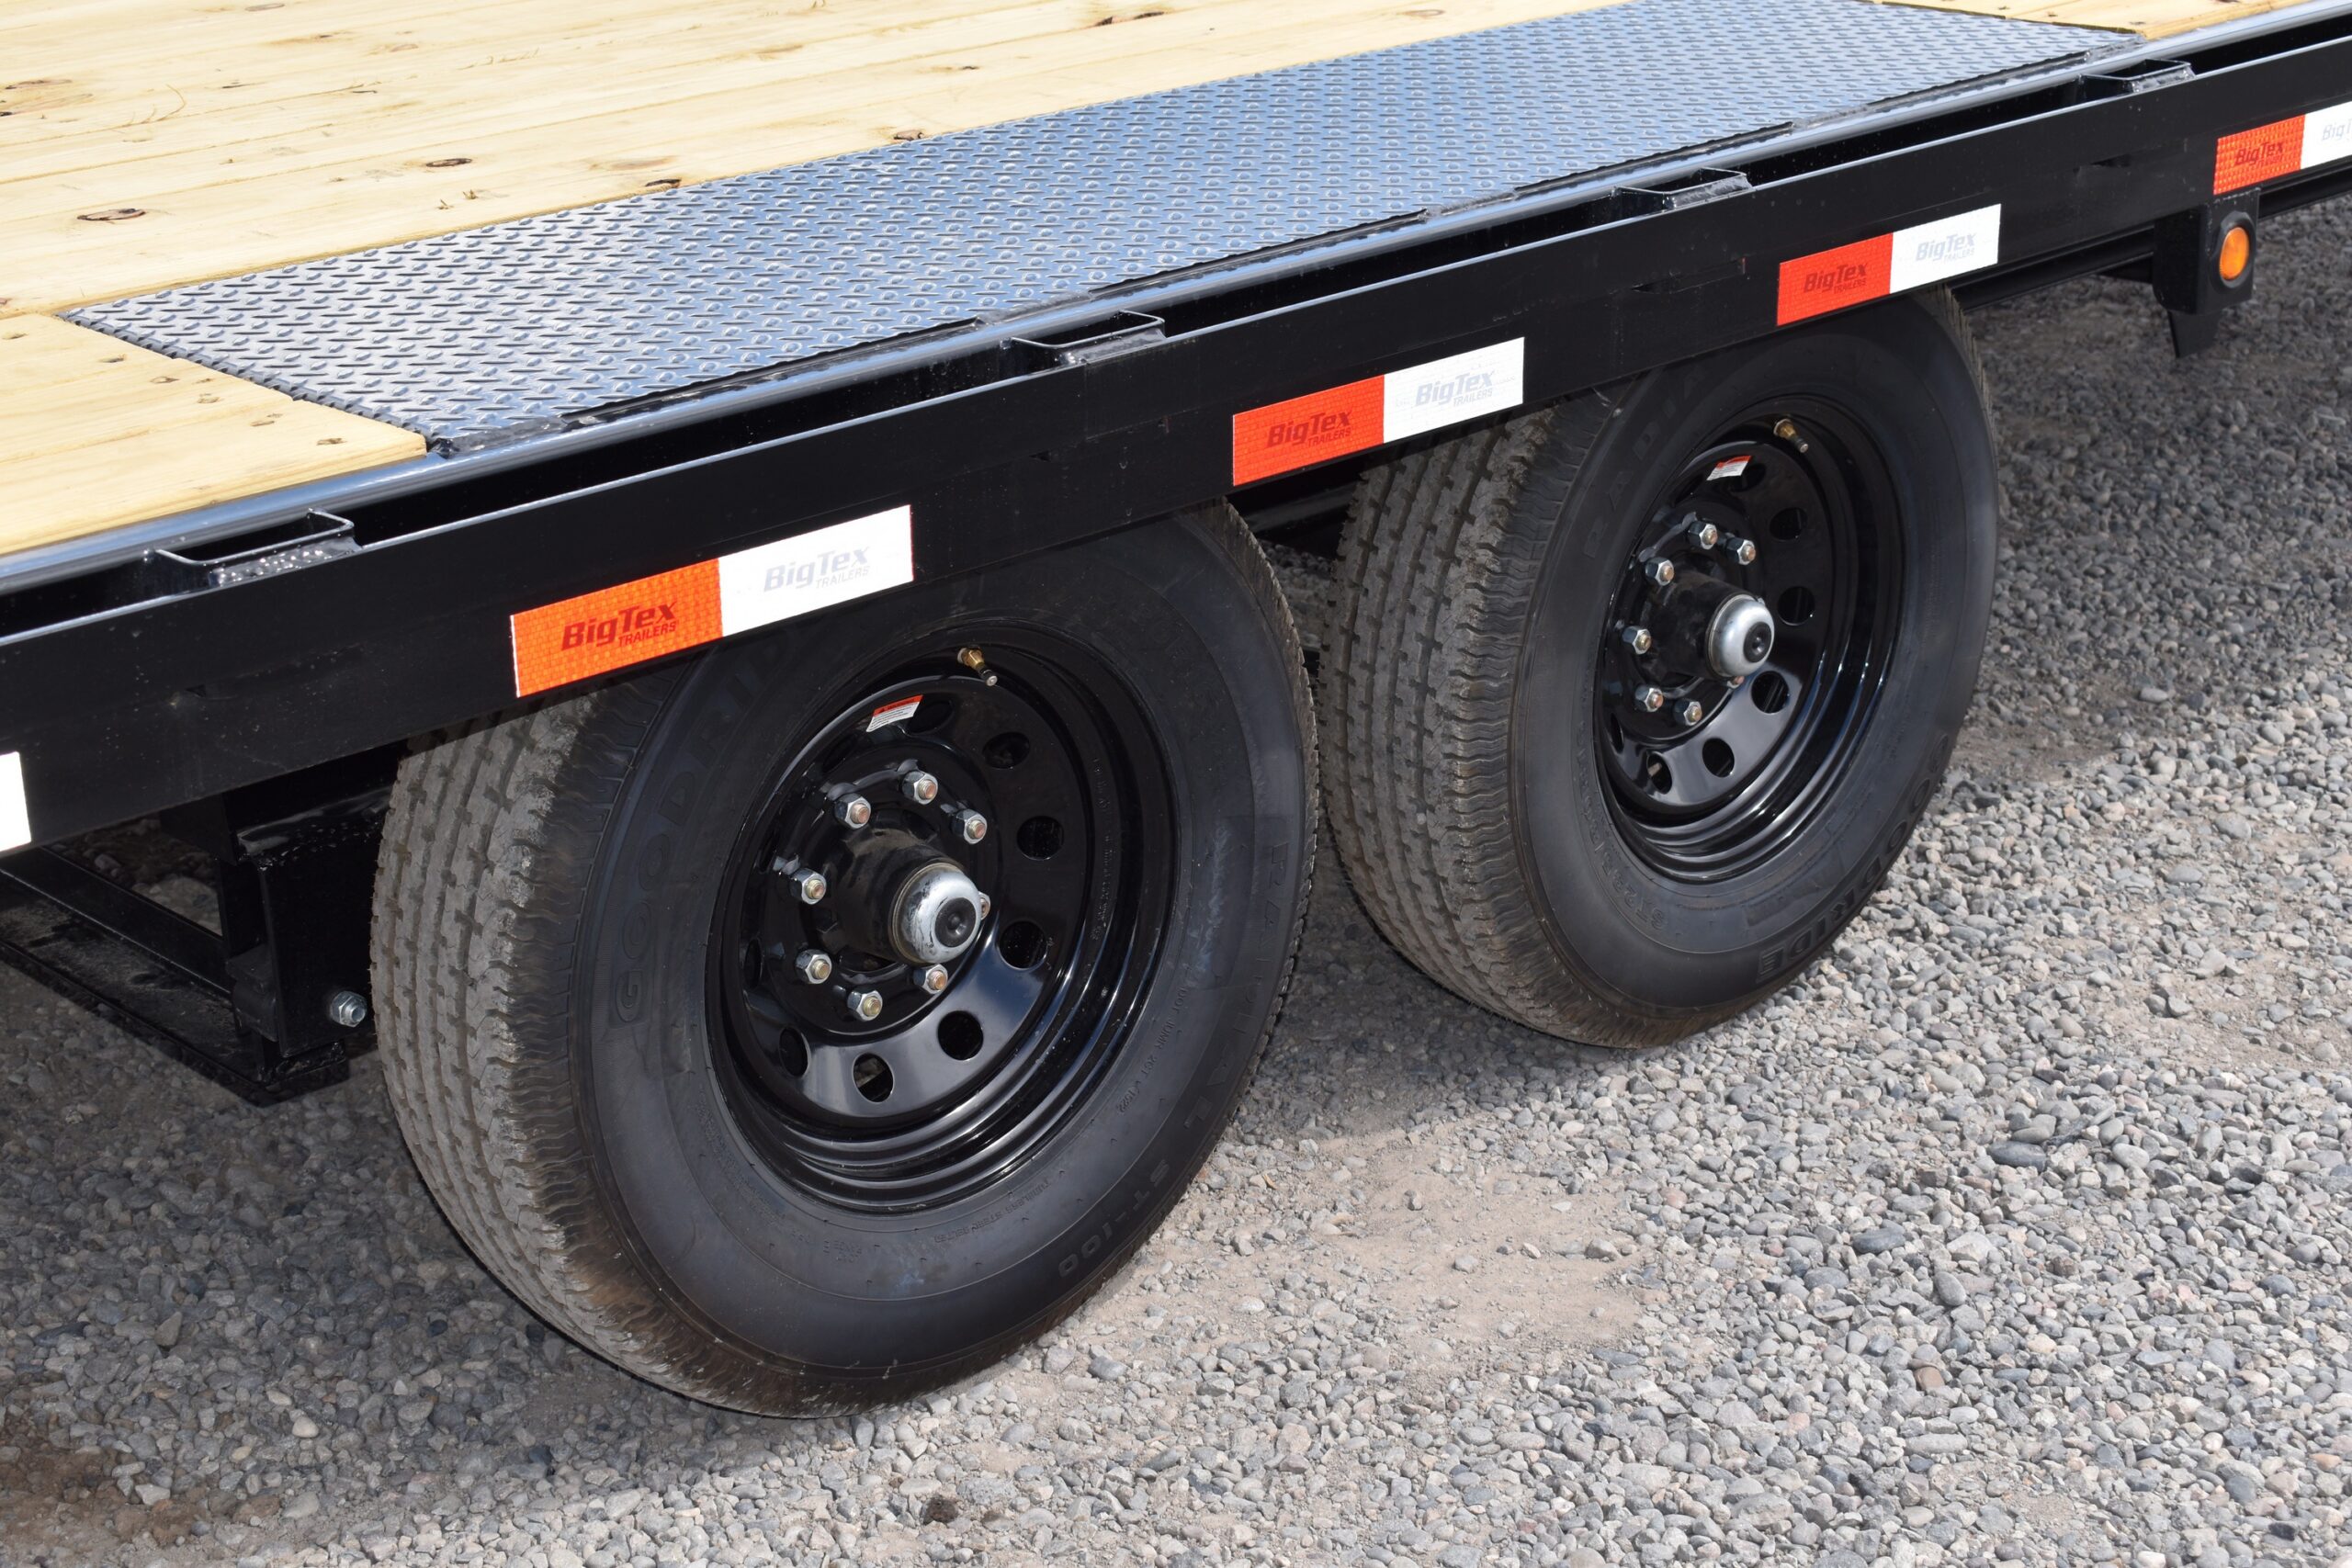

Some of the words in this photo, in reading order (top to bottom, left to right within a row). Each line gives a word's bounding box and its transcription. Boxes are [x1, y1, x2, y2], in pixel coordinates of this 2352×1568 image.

[2234, 141, 2284, 166] BigTex
[1915, 232, 1976, 262] BigTex
[1803, 263, 1868, 293] BigTex
[1834, 278, 1867, 295] TRAILERS
[1415, 370, 1495, 407] BigTex
[1453, 388, 1493, 407] TRAILERS
[1266, 408, 1353, 448] BigTex
[1307, 427, 1352, 448] TRAILERS
[1583, 365, 1710, 559] RADIA
[763, 546, 871, 592] BigTex
[815, 566, 871, 589] TRAILERS
[560, 602, 677, 651] BigTex
[618, 621, 677, 647] TRAILERS
[1758, 734, 1949, 980] GOODRIDE
[1171, 986, 1189, 1015] DOT
[1058, 1159, 1170, 1278] ST-100
